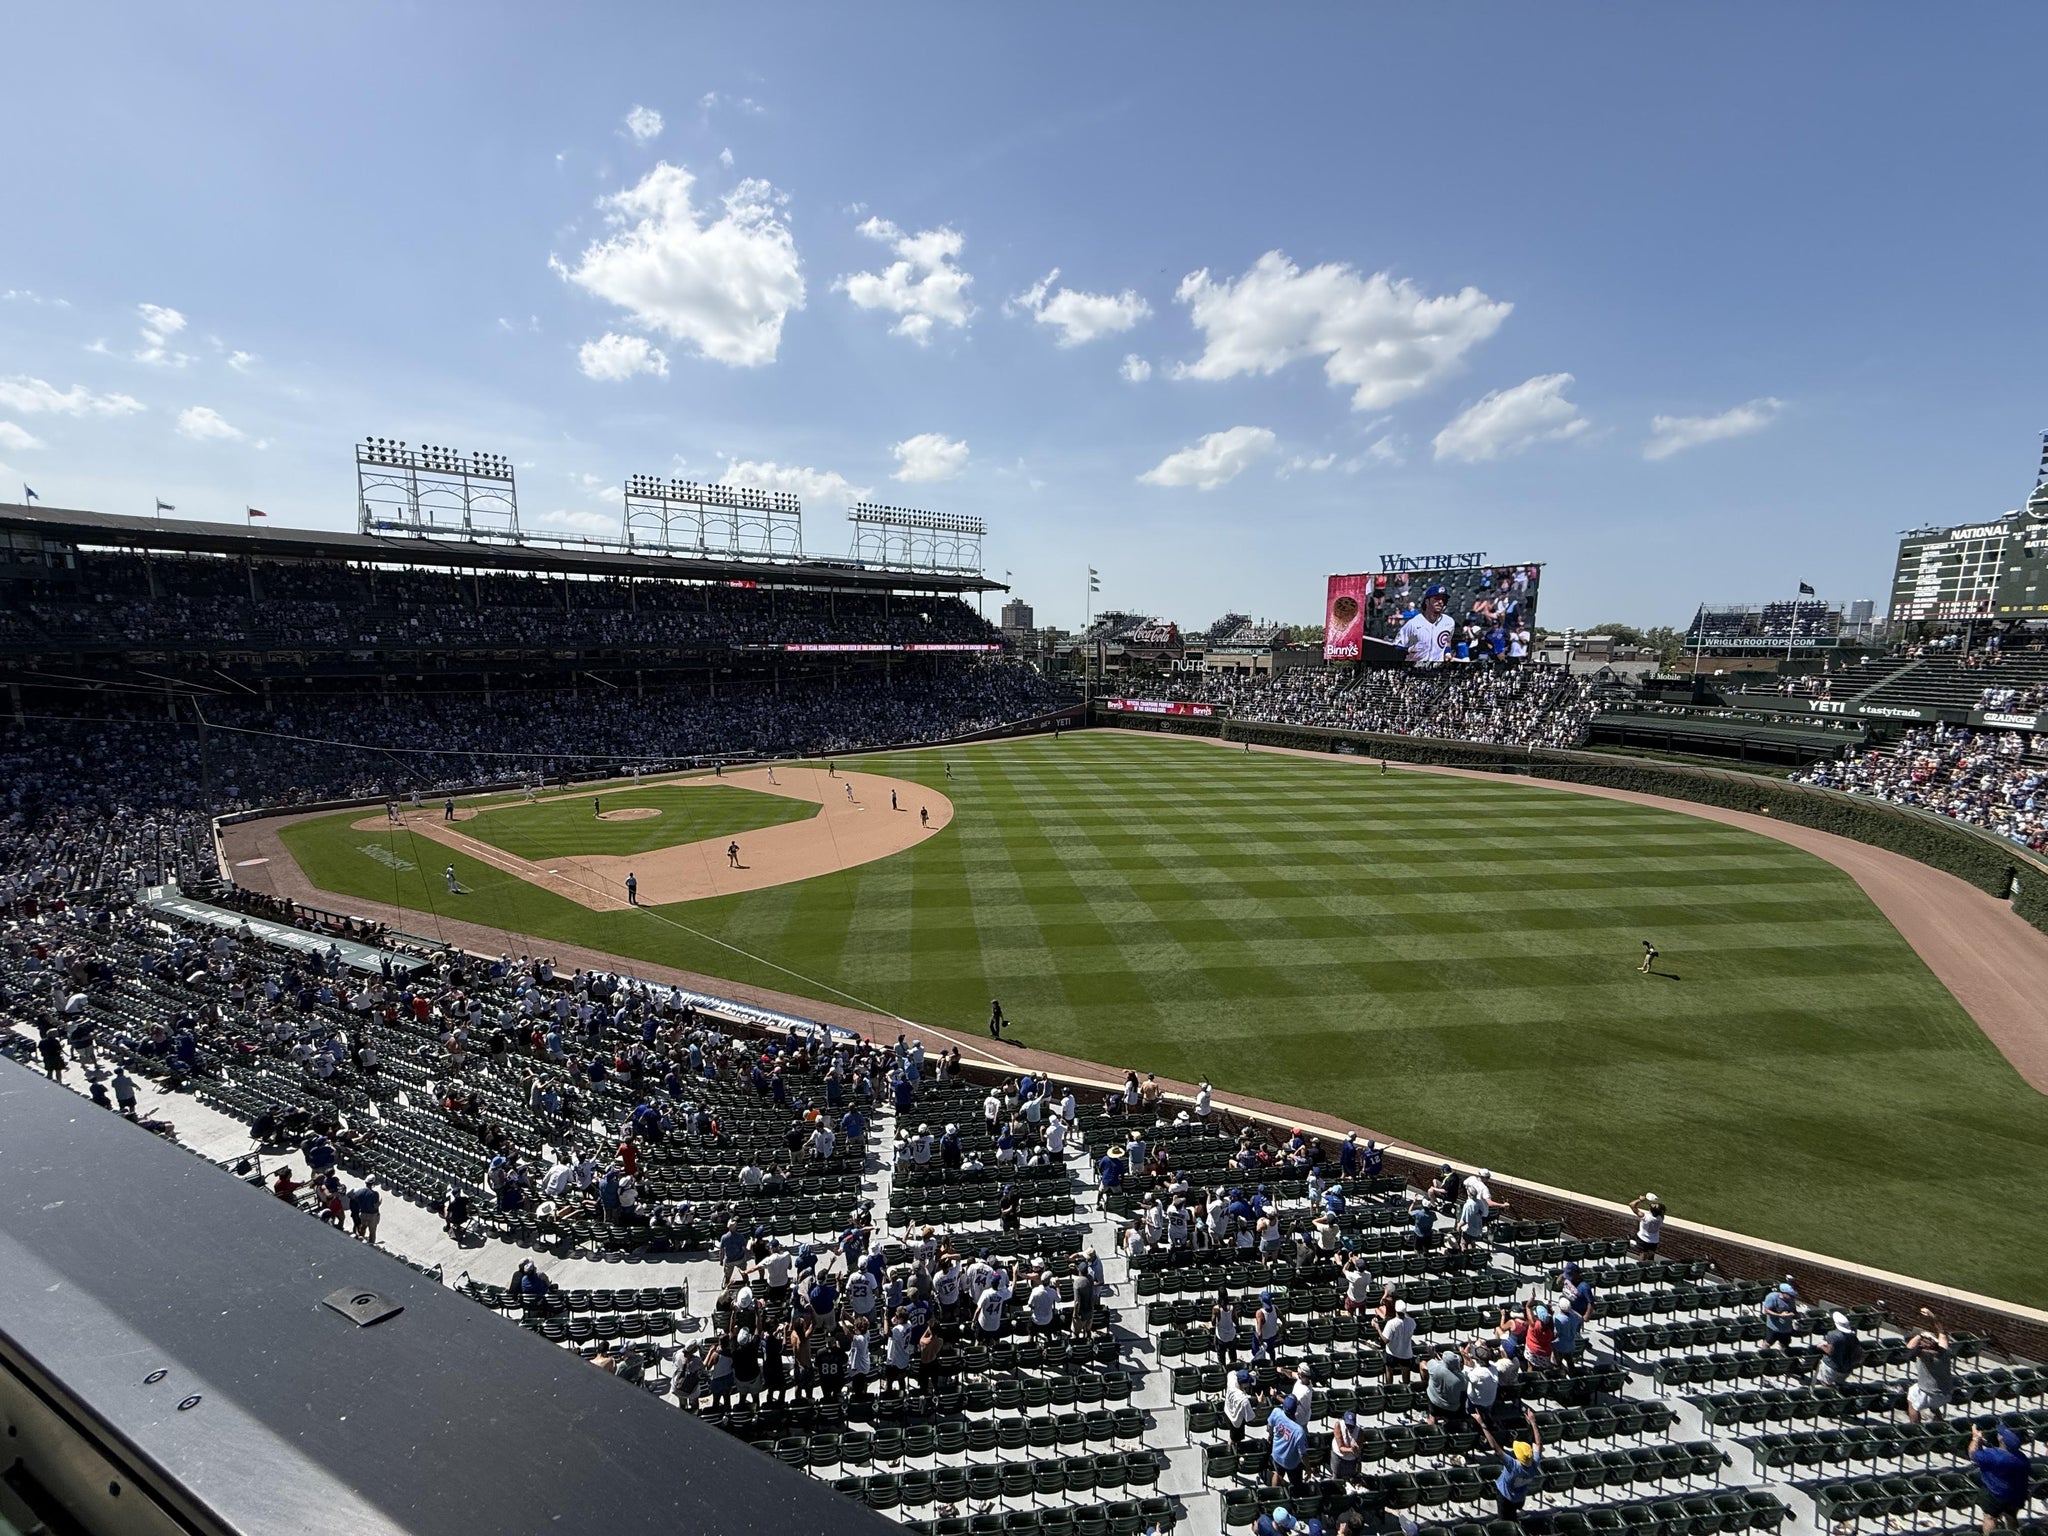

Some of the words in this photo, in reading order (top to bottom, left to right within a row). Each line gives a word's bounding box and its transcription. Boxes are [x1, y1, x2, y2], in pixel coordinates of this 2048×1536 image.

[1951, 525, 2010, 541] NATIONAL
[1379, 552, 1487, 571] WINTRUST
[1327, 640, 1359, 657] Binny's
[1808, 700, 1846, 713] YETI
[1866, 705, 1921, 718] tastytrade
[1056, 718, 1071, 727] YETI
[1983, 712, 2037, 724] GRAINGER
[916, 1144, 925, 1153] 17
[1370, 1155, 1380, 1165] 12
[942, 1283, 956, 1294] 12
[974, 1276, 986, 1288] 44
[853, 1285, 868, 1298] 23
[986, 1302, 1000, 1315] 44
[911, 1314, 925, 1328] 20
[822, 1362, 838, 1374] 88
